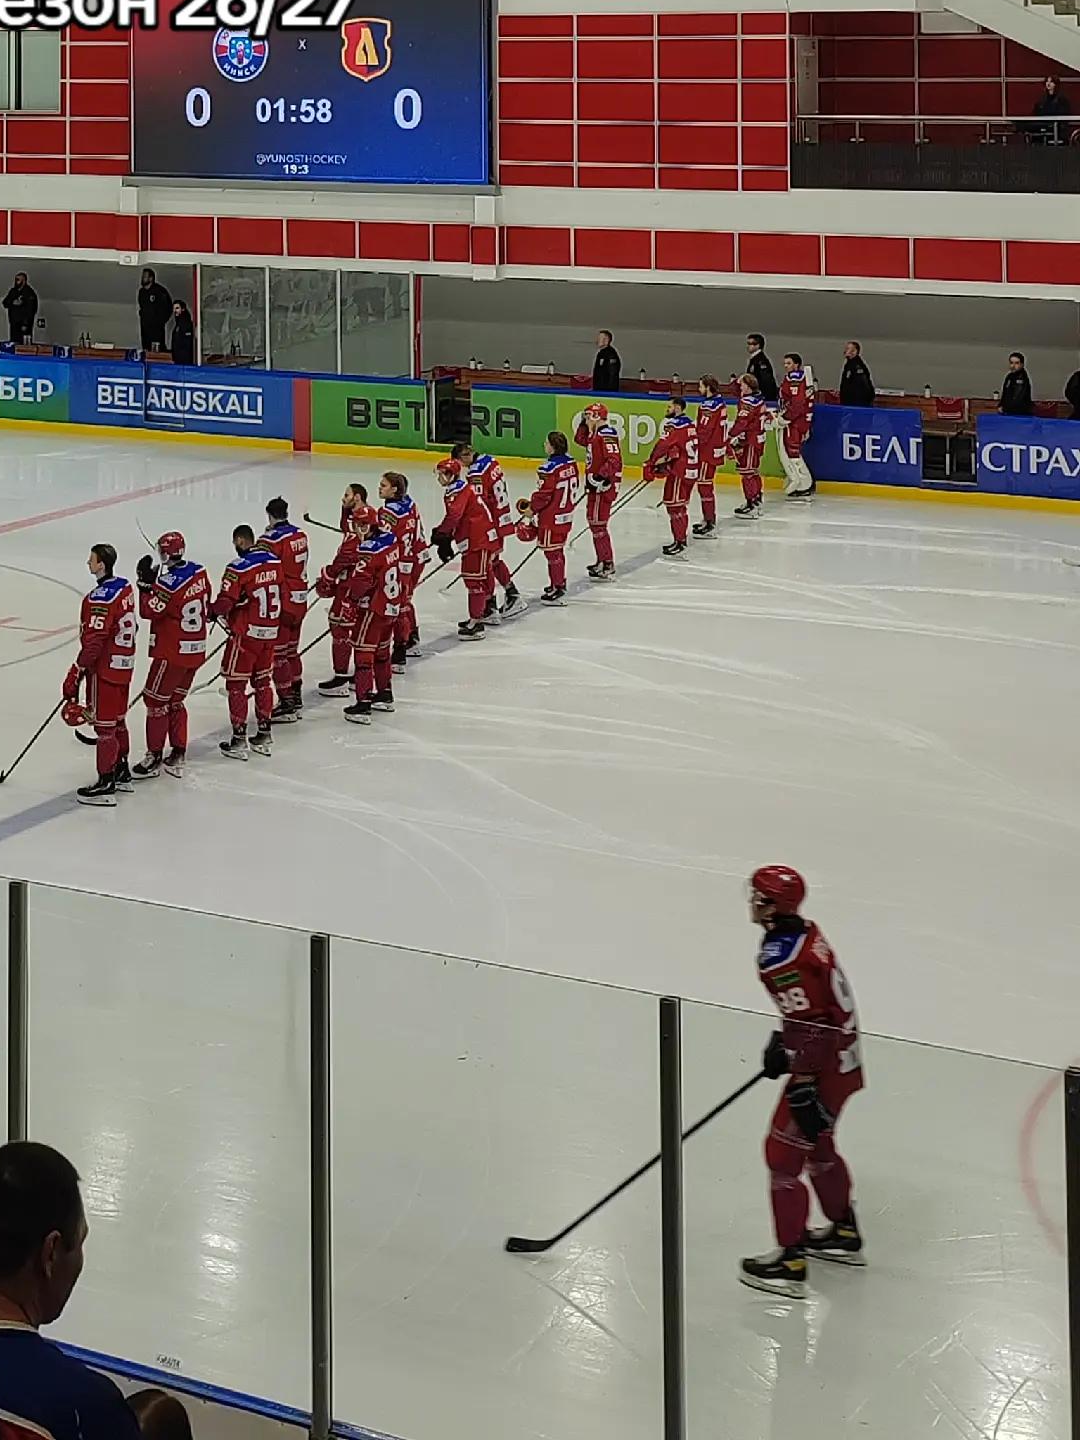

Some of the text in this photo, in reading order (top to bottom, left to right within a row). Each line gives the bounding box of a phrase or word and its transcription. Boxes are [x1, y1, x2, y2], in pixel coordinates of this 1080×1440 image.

[185, 87, 212, 127] 0
[255, 98, 333, 124] 01:58
[393, 88, 423, 129] 0
[97, 384, 263, 417] BELARUSKALI
[253, 585, 281, 620] 13
